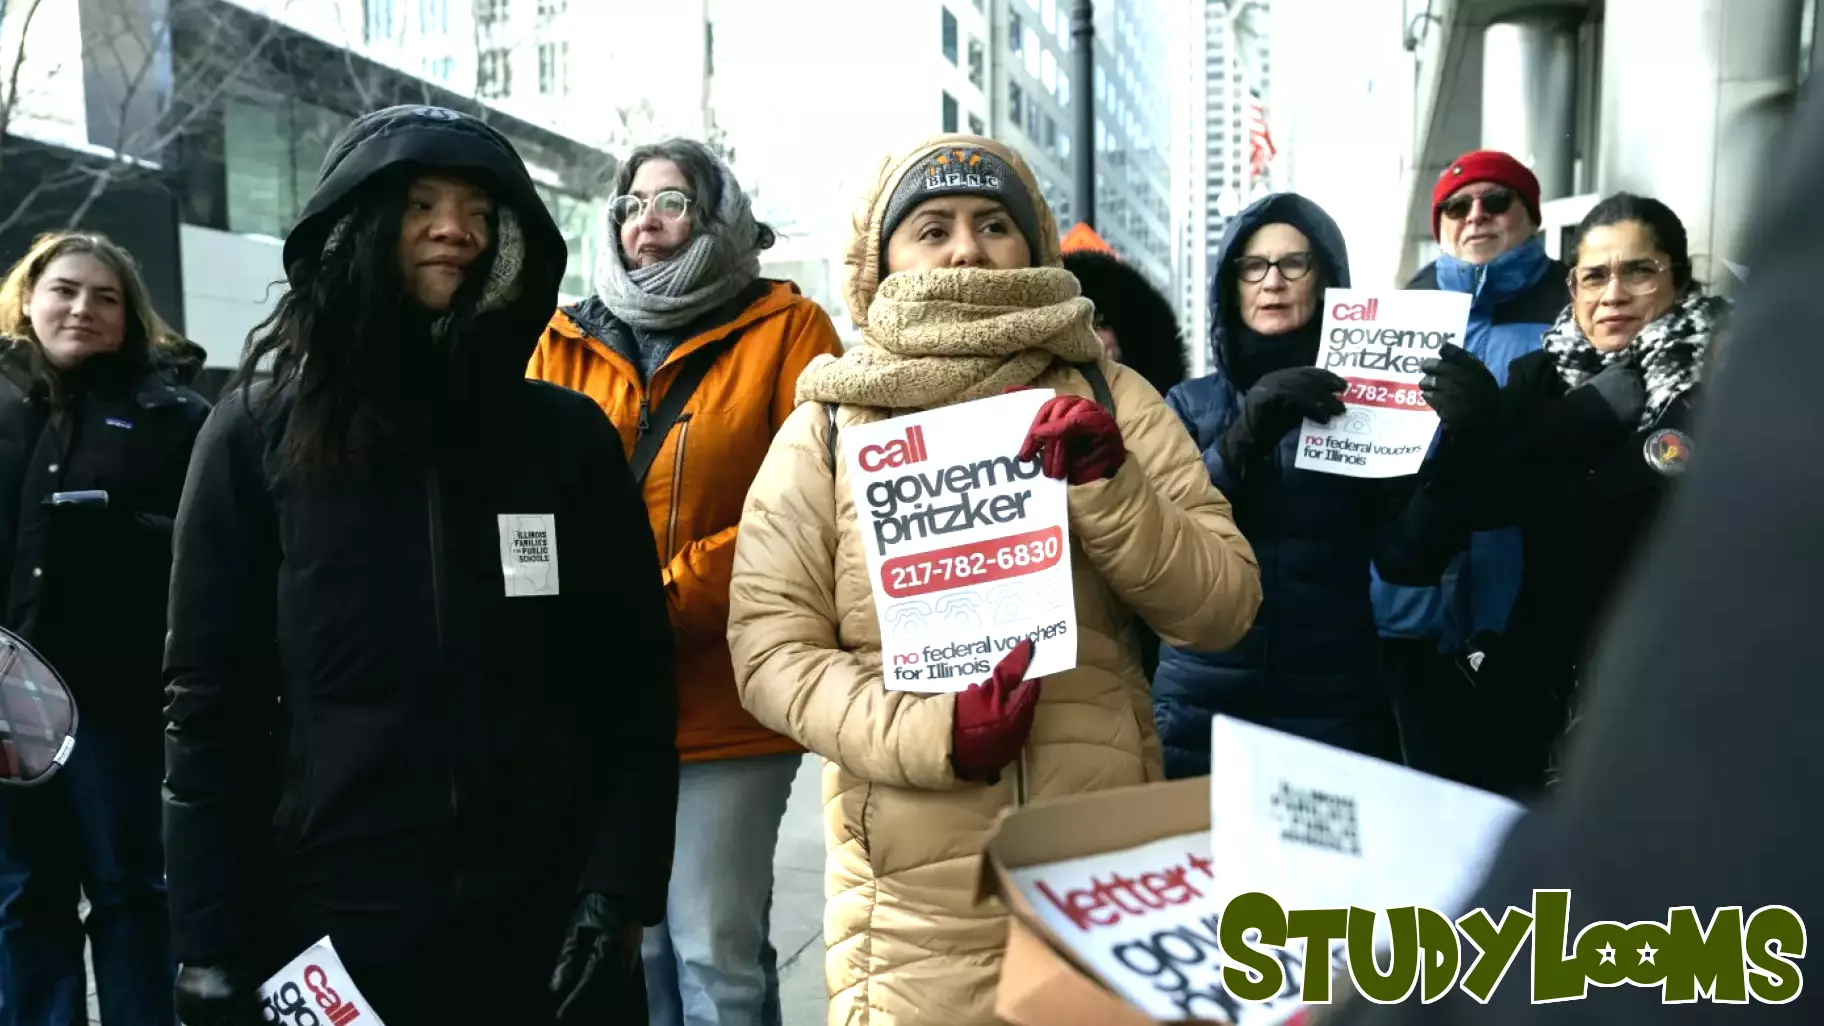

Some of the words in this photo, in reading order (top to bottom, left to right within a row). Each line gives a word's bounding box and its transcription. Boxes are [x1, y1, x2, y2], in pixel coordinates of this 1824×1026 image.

[1332, 298, 1378, 321] call
[1329, 328, 1455, 351] governor
[1324, 346, 1424, 374] pritzke
[858, 425, 928, 472] call
[1304, 447, 1323, 459] for
[1324, 452, 1366, 466] Illinois
[1305, 435, 1324, 446] no
[1326, 435, 1372, 454] federal
[1374, 441, 1422, 456] vouchers
[866, 454, 1042, 518] governo
[517, 531, 546, 539] ILLINOIS
[872, 490, 1032, 556] pritzker
[522, 547, 548, 555] PUBLIC
[891, 537, 1058, 589] 217-782-6830
[893, 652, 919, 666] no
[922, 636, 992, 663] federal
[894, 667, 923, 680] for
[927, 658, 990, 680] Illinois
[1034, 865, 1204, 931] letter
[304, 964, 360, 1026] call
